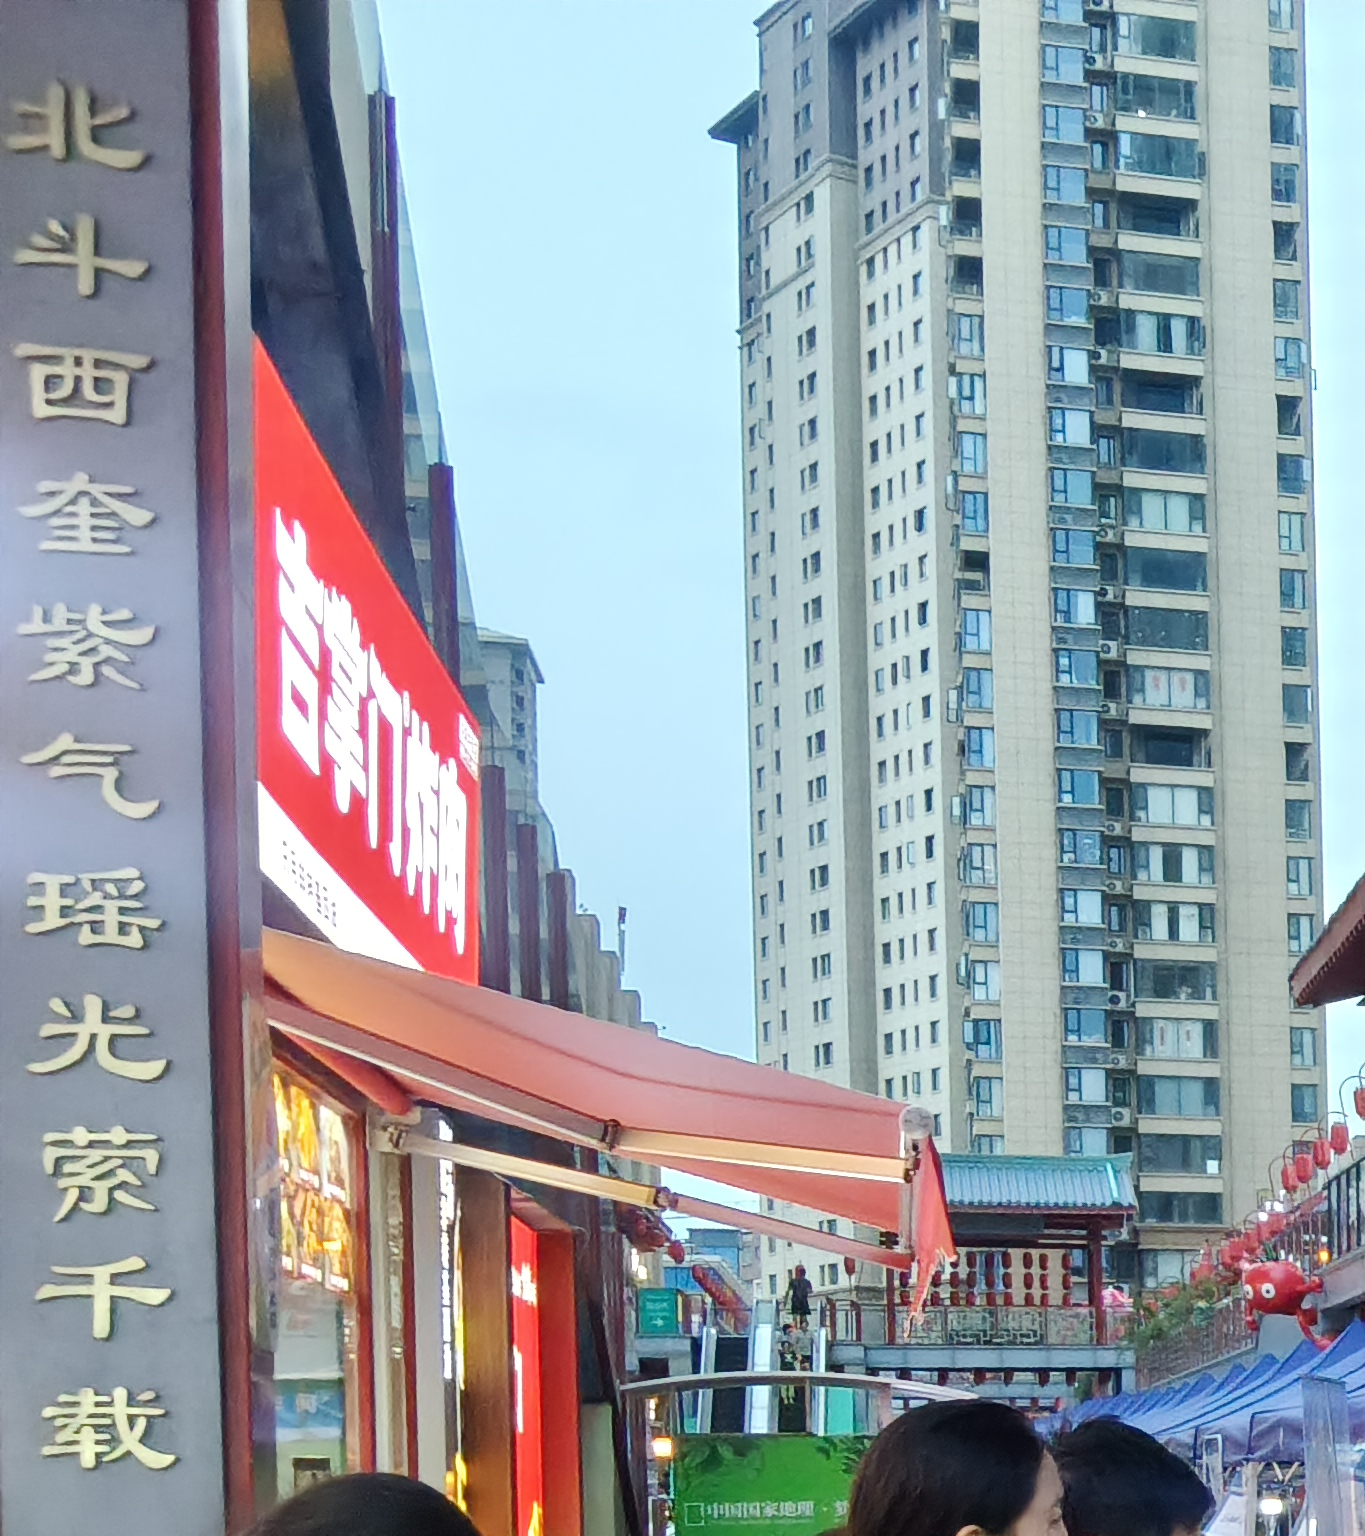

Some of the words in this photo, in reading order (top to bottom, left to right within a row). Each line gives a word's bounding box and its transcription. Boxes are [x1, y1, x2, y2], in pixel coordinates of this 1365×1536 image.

[5, 79, 177, 1470] 北斗西奎紫气瑶光萦千载
[706, 1500, 815, 1519] 中国国家地理
